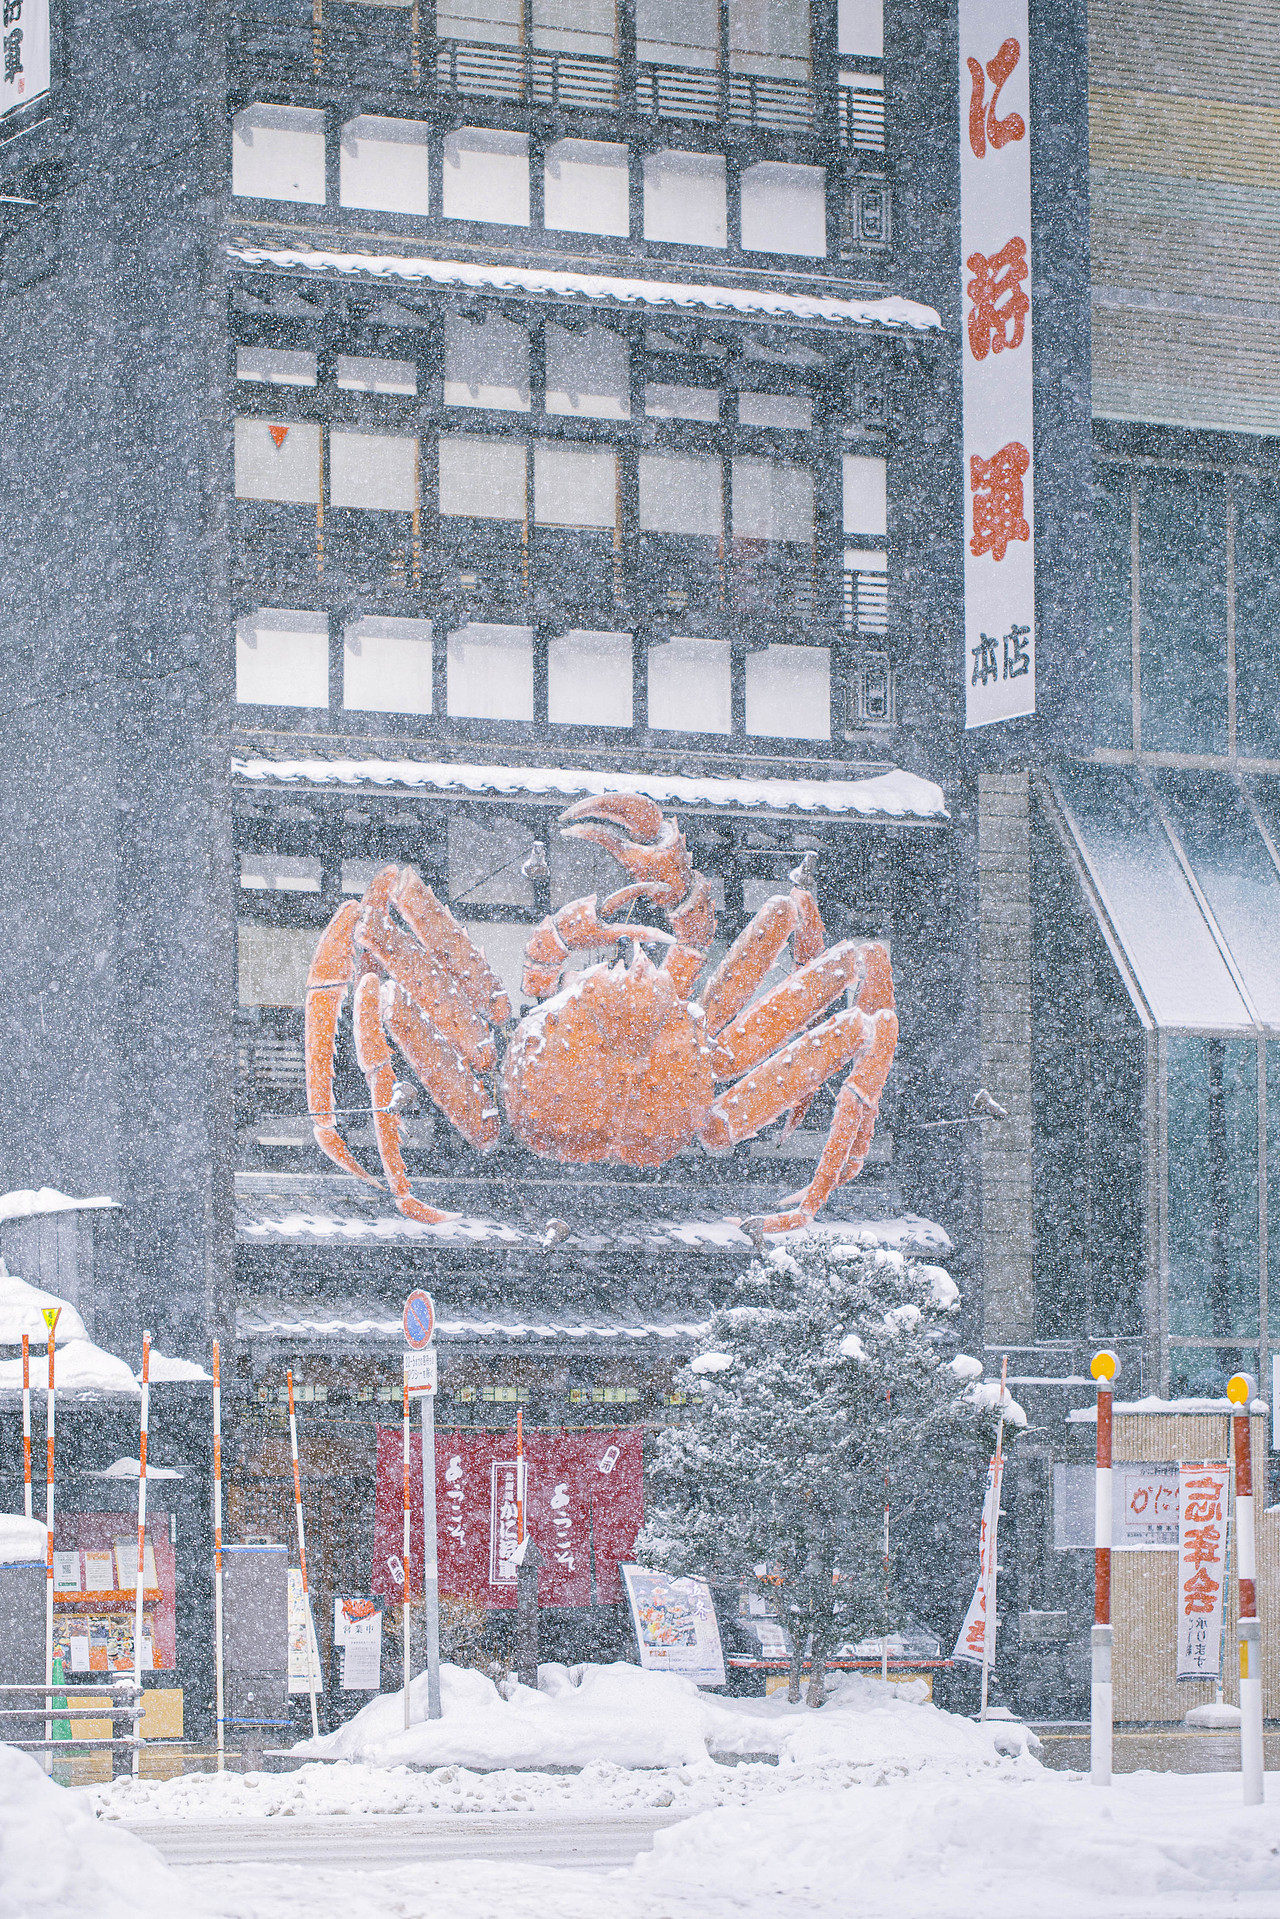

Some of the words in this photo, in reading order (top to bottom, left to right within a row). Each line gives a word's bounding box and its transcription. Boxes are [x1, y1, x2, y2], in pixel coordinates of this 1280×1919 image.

[971, 624, 1031, 687] 本店
[445, 1455, 466, 1547] ようこそ
[550, 1483, 576, 1571] ようこそ
[1130, 1485, 1179, 1514] かに
[343, 1624, 374, 1634] 営業中
